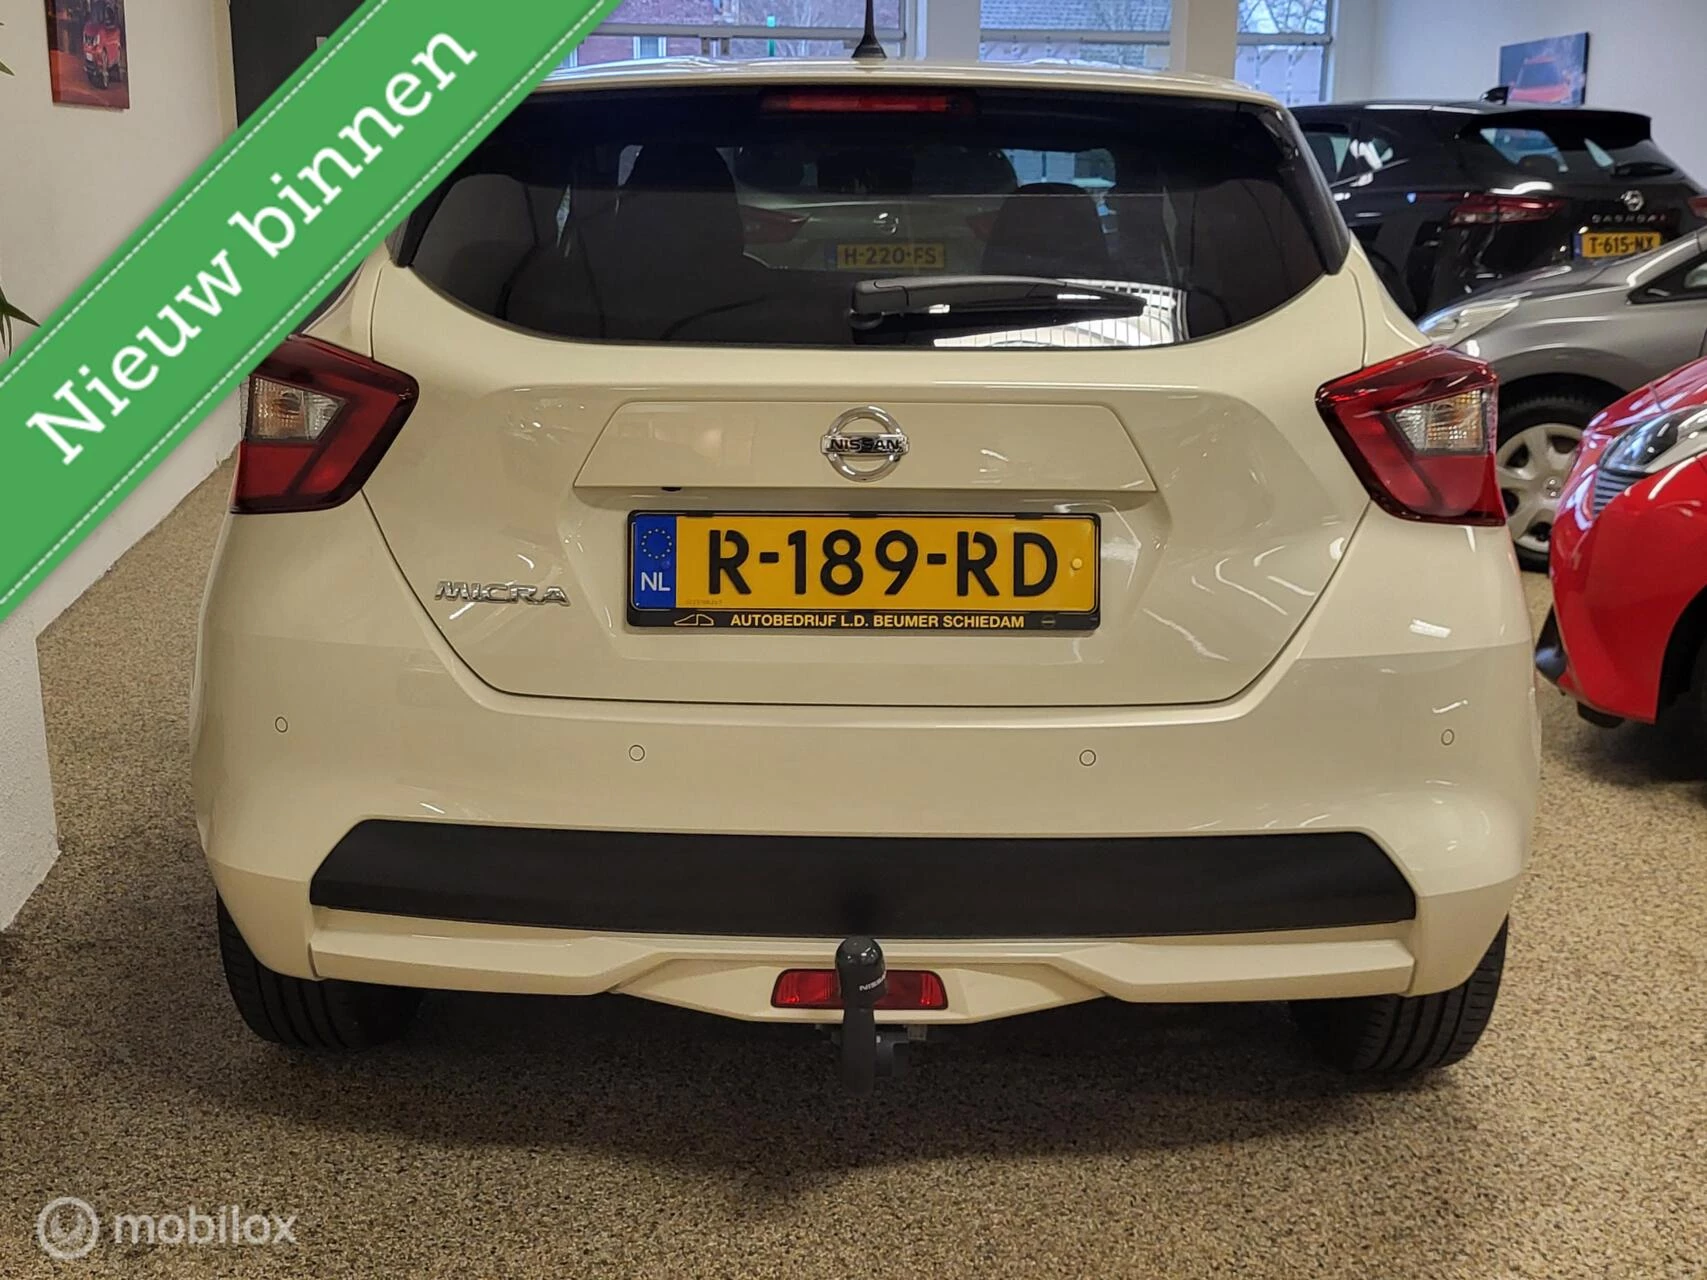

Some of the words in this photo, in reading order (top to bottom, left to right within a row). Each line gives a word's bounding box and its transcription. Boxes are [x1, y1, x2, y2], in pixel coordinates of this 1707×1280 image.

[843, 246, 937, 265] H-220-FS
[830, 438, 900, 451] NISSAN
[708, 529, 1058, 597] R-189-RD
[640, 571, 671, 592] NL
[434, 580, 571, 607] MICRA
[730, 614, 836, 627] AUTOBEDRIJF
[840, 614, 869, 627] L.D.
[873, 615, 939, 628] BEUMER
[942, 615, 1024, 628] SCHIEDAM
